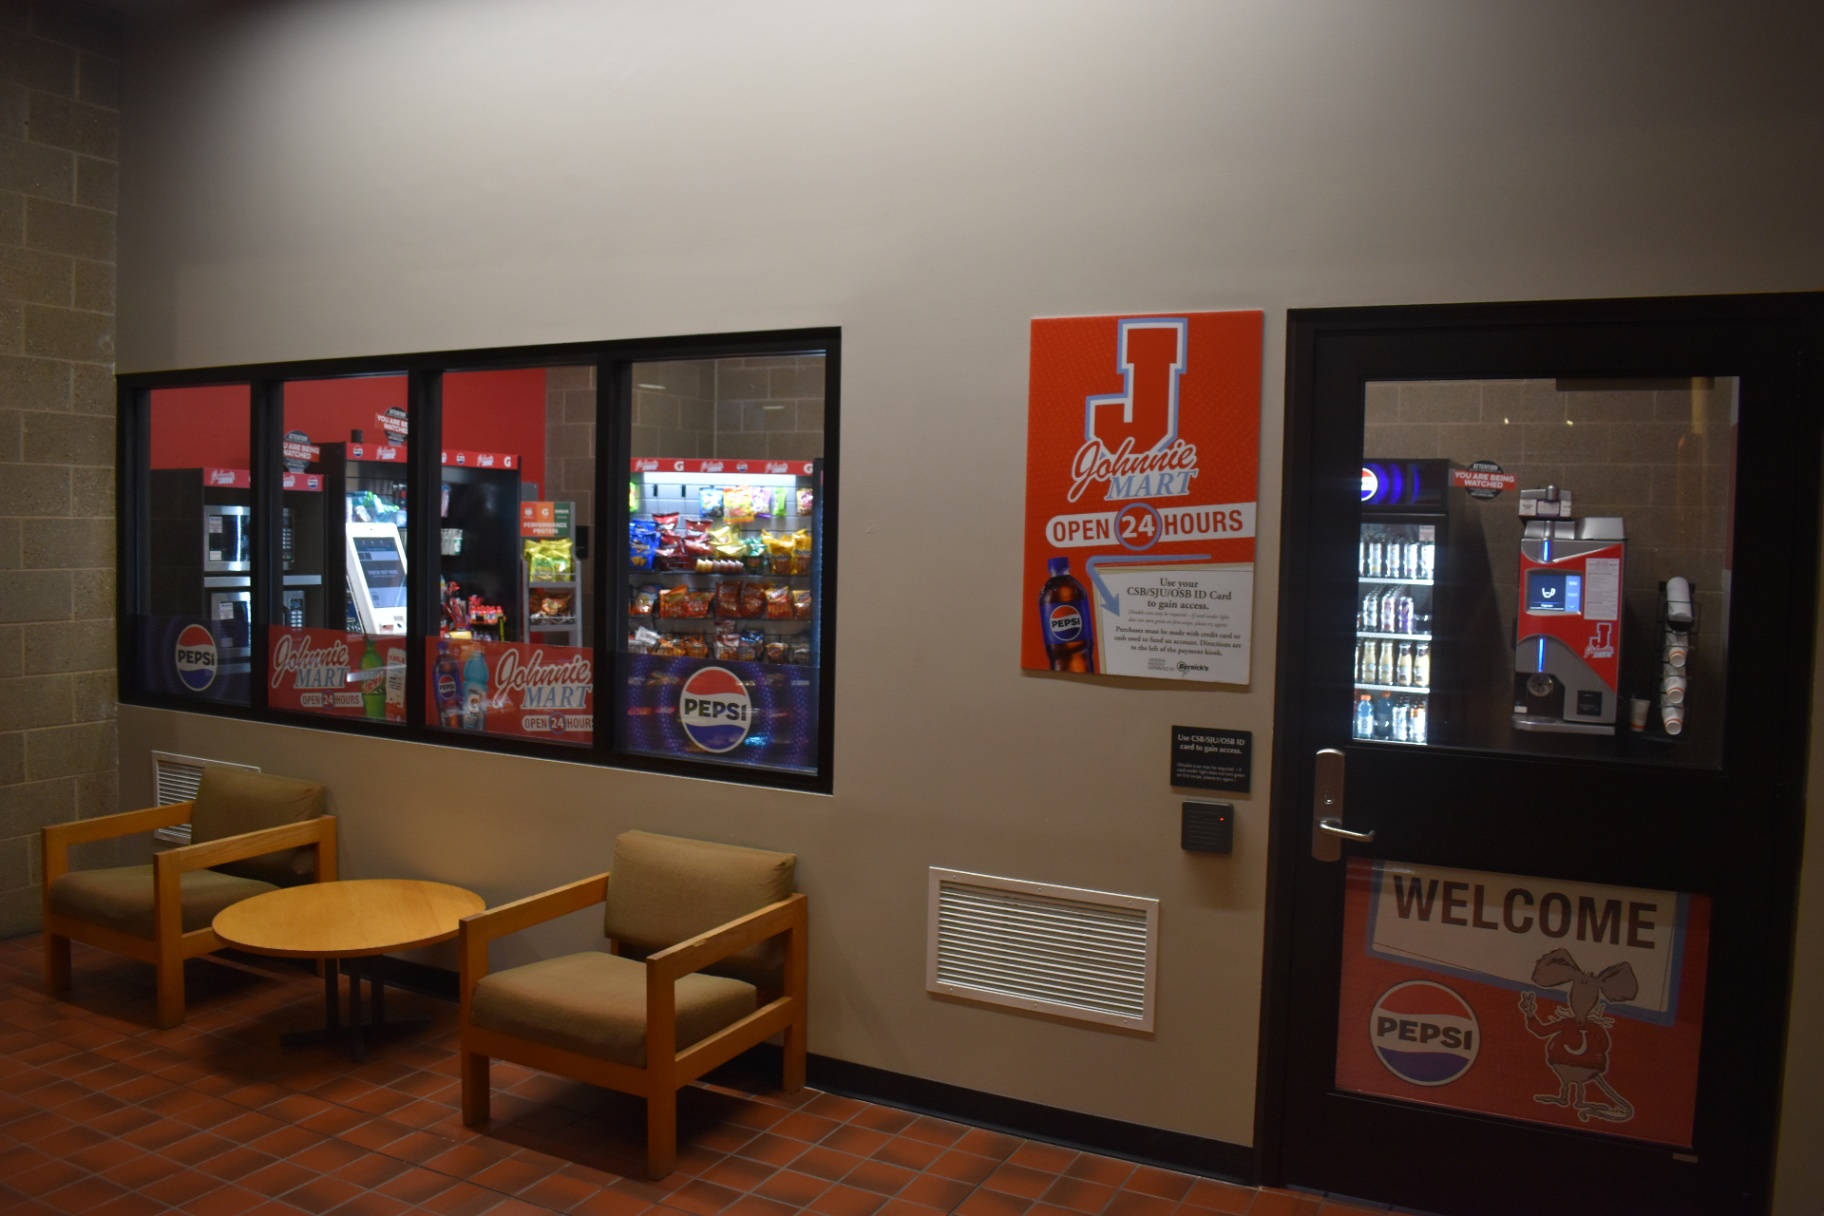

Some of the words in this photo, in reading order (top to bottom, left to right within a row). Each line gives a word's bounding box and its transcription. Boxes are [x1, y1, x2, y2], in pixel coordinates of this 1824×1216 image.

[1068, 437, 1197, 502] Johnnie
[1454, 471, 1471, 479] YOU
[1490, 474, 1514, 482] BEING
[1106, 470, 1198, 500] MART
[1464, 479, 1503, 488] WATCHED
[1053, 518, 1110, 542] OPEN
[1122, 514, 1155, 539] 24
[1165, 509, 1243, 536] HOURS
[1160, 578, 1176, 587] Use
[1178, 580, 1198, 589] your
[1127, 586, 1191, 599] CSB/SJU/OSB
[1194, 590, 1207, 600] ID
[1209, 591, 1232, 601] Card
[1158, 600, 1177, 610] gain
[1180, 602, 1209, 610] access.
[1052, 618, 1080, 628] PEPSI
[1115, 625, 1143, 634] Purchases
[178, 650, 215, 666] PEPSI
[272, 635, 349, 688] Johnnie
[294, 666, 350, 688] MART
[493, 649, 591, 708] Johnnie
[303, 695, 320, 704] OPEN
[323, 694, 333, 705] 24
[335, 695, 360, 704] HOURS
[522, 685, 593, 708] MART
[685, 698, 747, 721] PEPSI
[525, 717, 547, 728] OPEN
[551, 716, 565, 728] 24
[1204, 745, 1218, 753] gain
[1393, 875, 1657, 949] WELCOME
[1377, 1016, 1473, 1051] PEPSI
